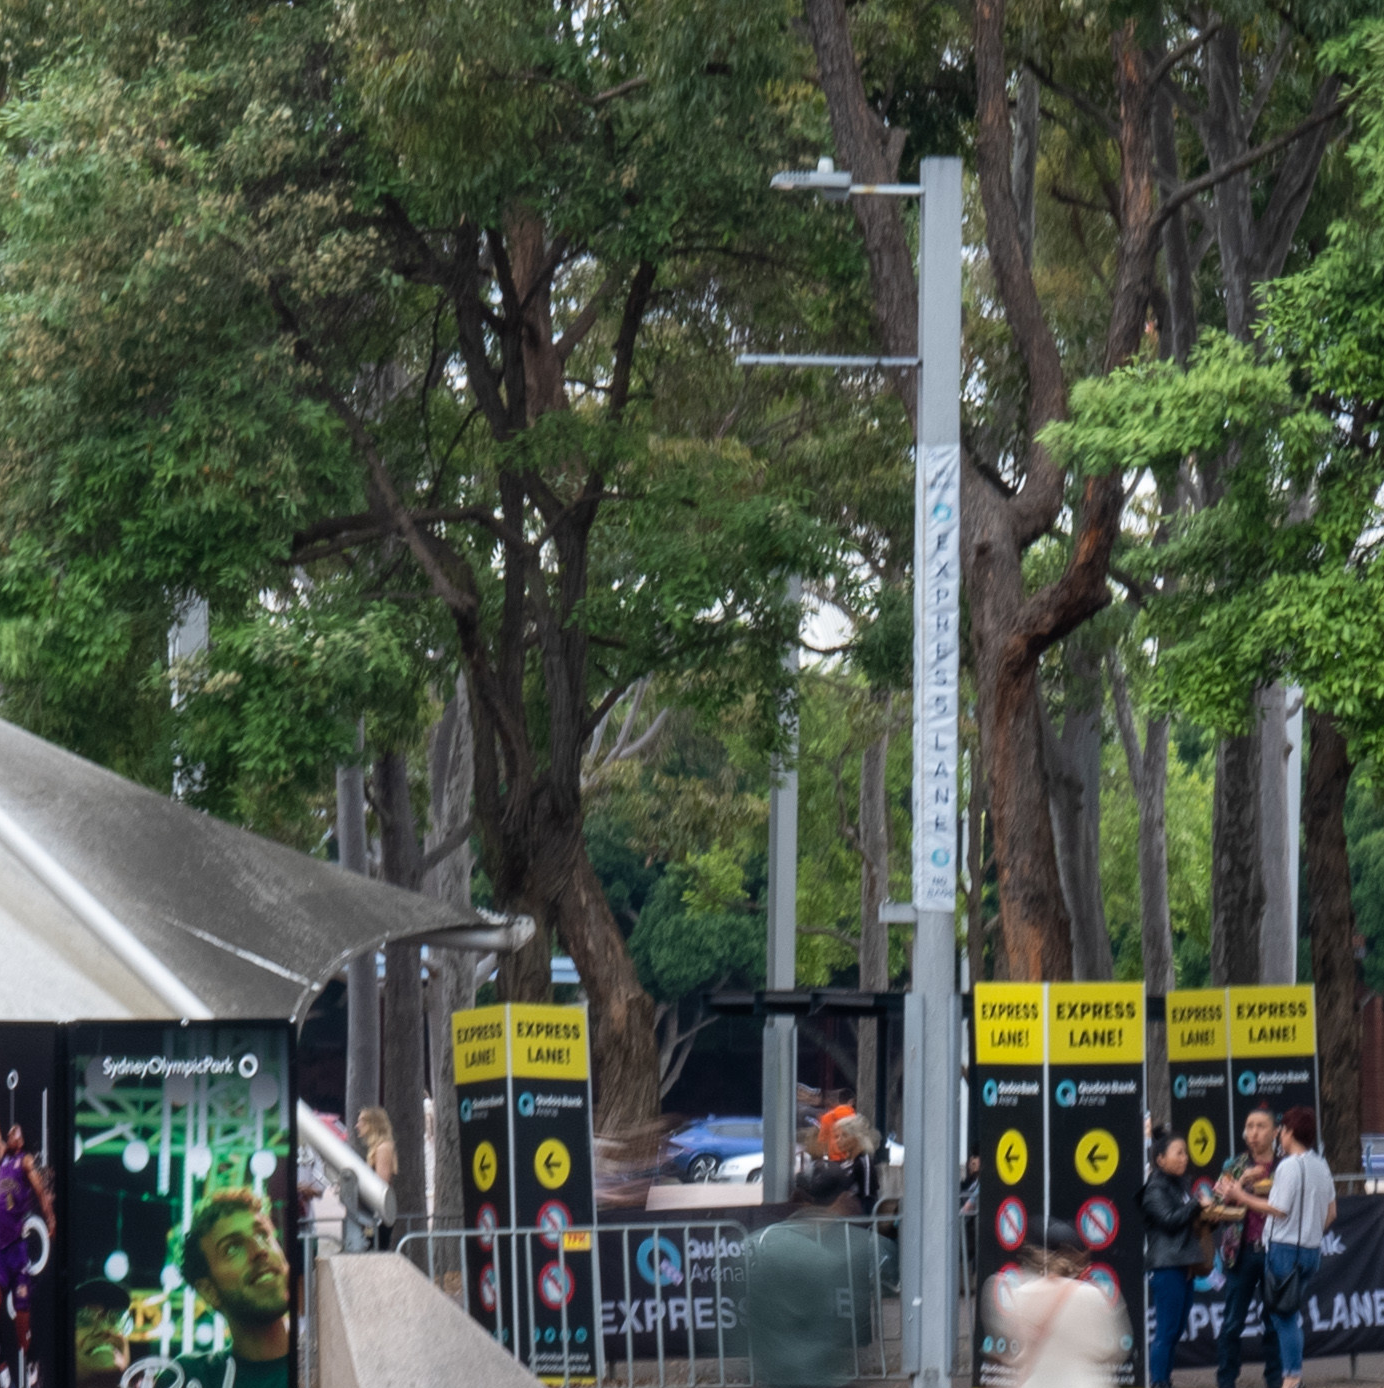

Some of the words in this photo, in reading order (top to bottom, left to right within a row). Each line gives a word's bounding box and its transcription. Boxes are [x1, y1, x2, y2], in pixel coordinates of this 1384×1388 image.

[934, 732, 949, 832] LANE
[981, 1001, 1039, 1021] EXPRESS
[1056, 1001, 1136, 1021] EXPRESS
[1171, 1004, 1223, 1024] EXPRESS
[1235, 1001, 1308, 1020] EXPRESS
[456, 1022, 502, 1045] EXPRESS
[517, 1020, 580, 1041] EXPRESS
[991, 1028, 1029, 1048] LANE!
[1069, 1028, 1122, 1048] LANE!
[1180, 1028, 1215, 1048] LANE!
[1248, 1024, 1297, 1045] LANE!
[465, 1047, 496, 1069] LANE!
[527, 1046, 570, 1066] LANE!
[103, 1055, 234, 1079] SydneyOlympicPark
